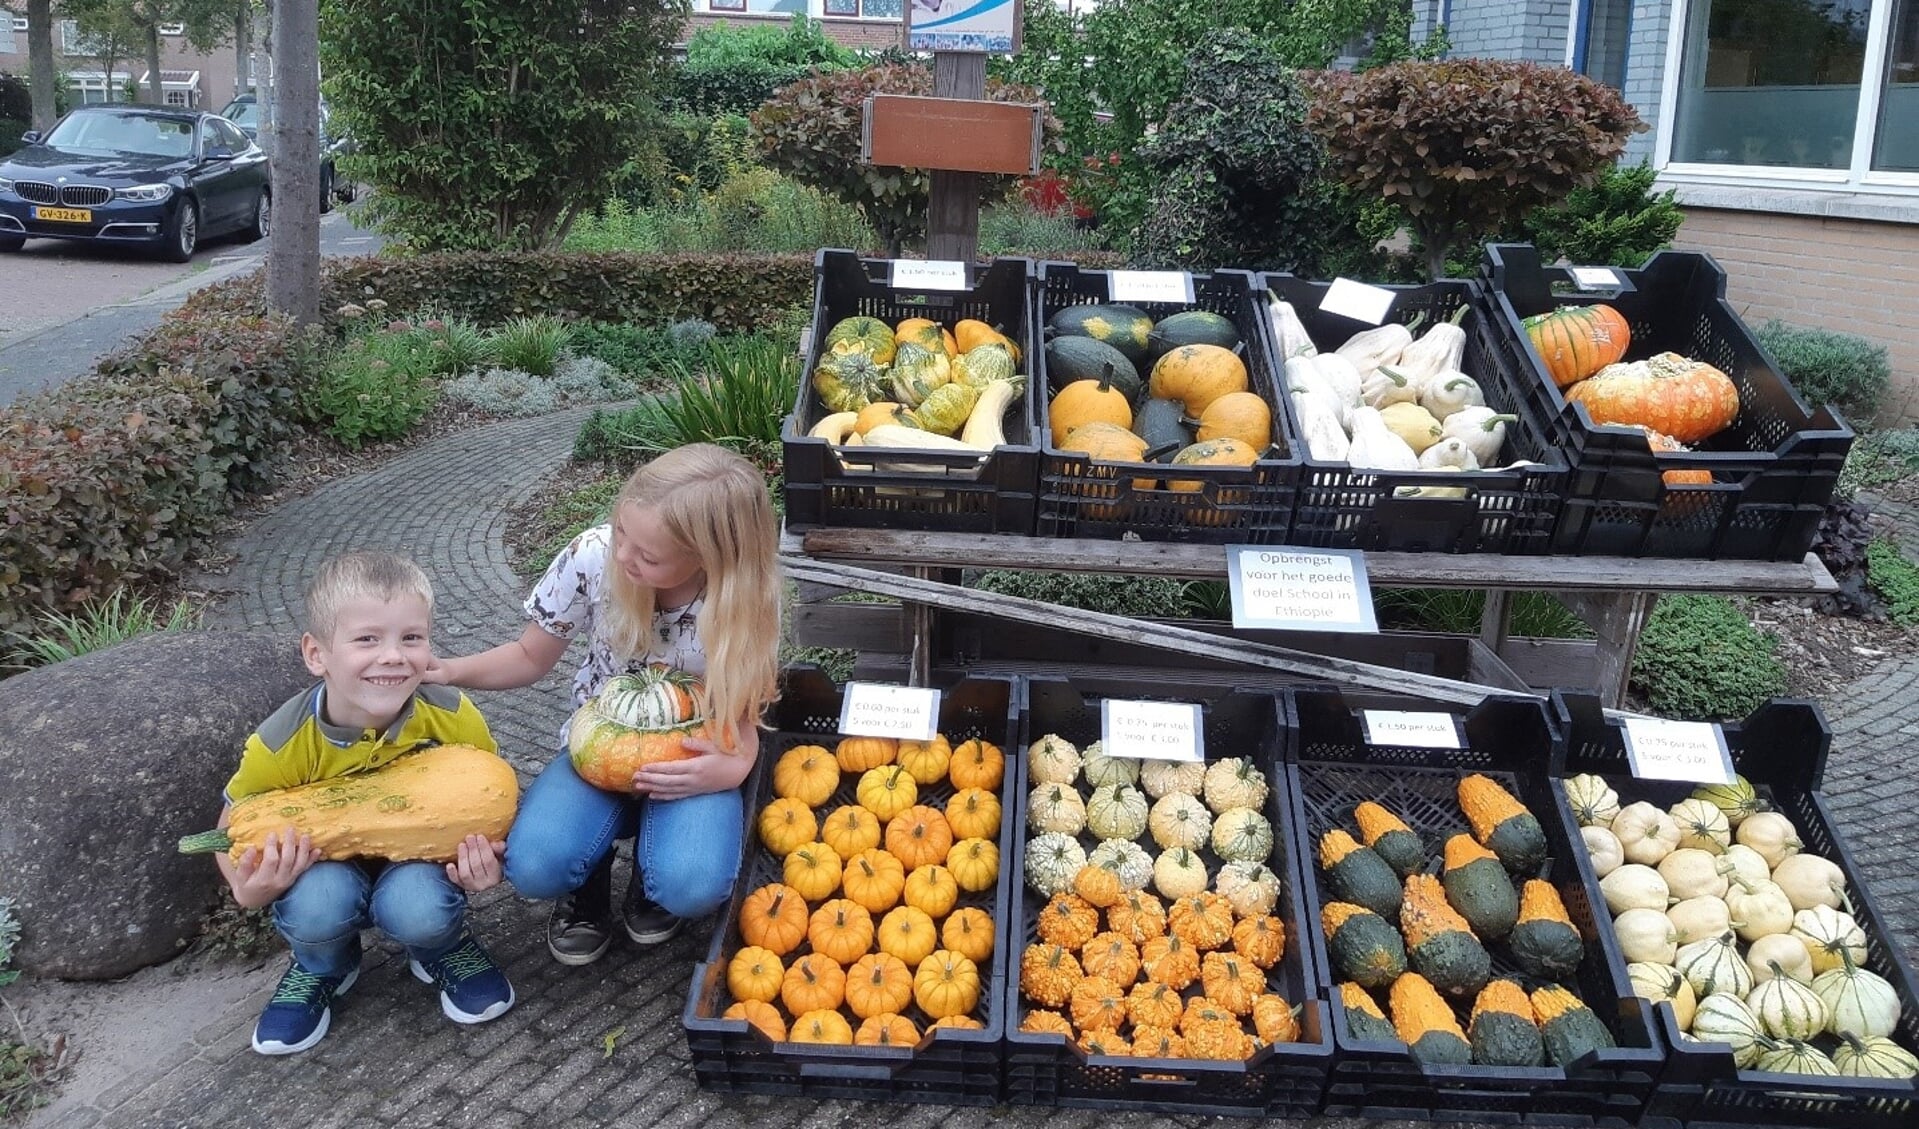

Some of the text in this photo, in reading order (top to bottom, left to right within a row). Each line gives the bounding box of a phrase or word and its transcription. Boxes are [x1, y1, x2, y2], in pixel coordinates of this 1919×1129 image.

[1260, 552, 1333, 567] Opbrengst
[1246, 570, 1352, 584] voor het goede
[1253, 588, 1351, 600] doel School in
